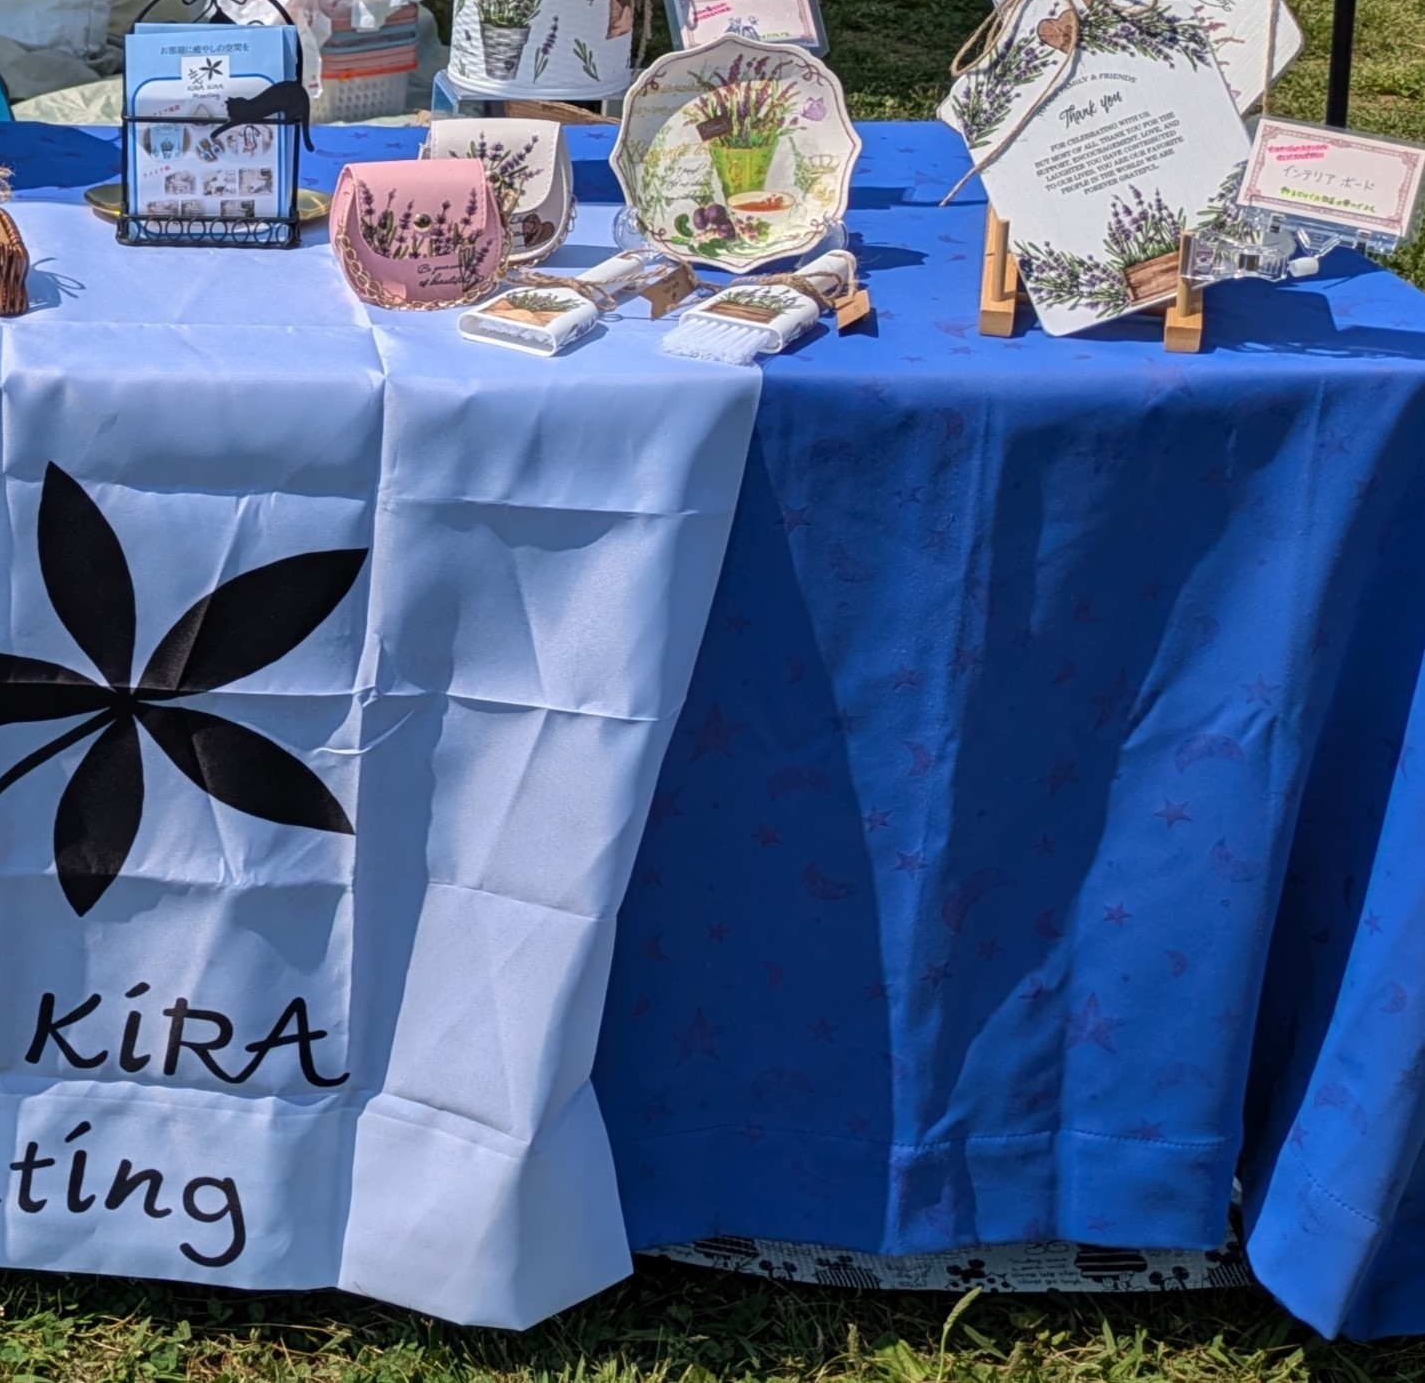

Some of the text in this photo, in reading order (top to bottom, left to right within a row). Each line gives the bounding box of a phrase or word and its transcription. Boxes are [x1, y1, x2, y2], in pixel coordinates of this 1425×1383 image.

[160, 43, 249, 55] お部屋に癒やしの空間を
[1098, 73, 1137, 84] FRIENDS
[1058, 100, 1098, 129] Thank
[1100, 90, 1123, 113] you
[1050, 141, 1066, 152] FOR
[1066, 123, 1118, 146] CELEBRATING
[1164, 119, 1180, 130] AND
[1034, 158, 1050, 168] BUT
[1051, 150, 1071, 162] MOST
[1072, 146, 1083, 154] OF
[1125, 124, 1142, 134] YOU
[1142, 118, 1158, 128] FOR
[1085, 157, 1102, 167] YOU
[1102, 149, 1123, 162] HAVE
[1123, 130, 1177, 153] CONTRIBUTED
[1045, 183, 1056, 191] TO
[1096, 161, 1113, 172] YOU
[1129, 150, 1147, 160] OUR
[1146, 136, 1184, 154] FAVORITE
[1061, 179, 1090, 195] PEOPLE
[1283, 164, 1375, 192] インテリア ボード
